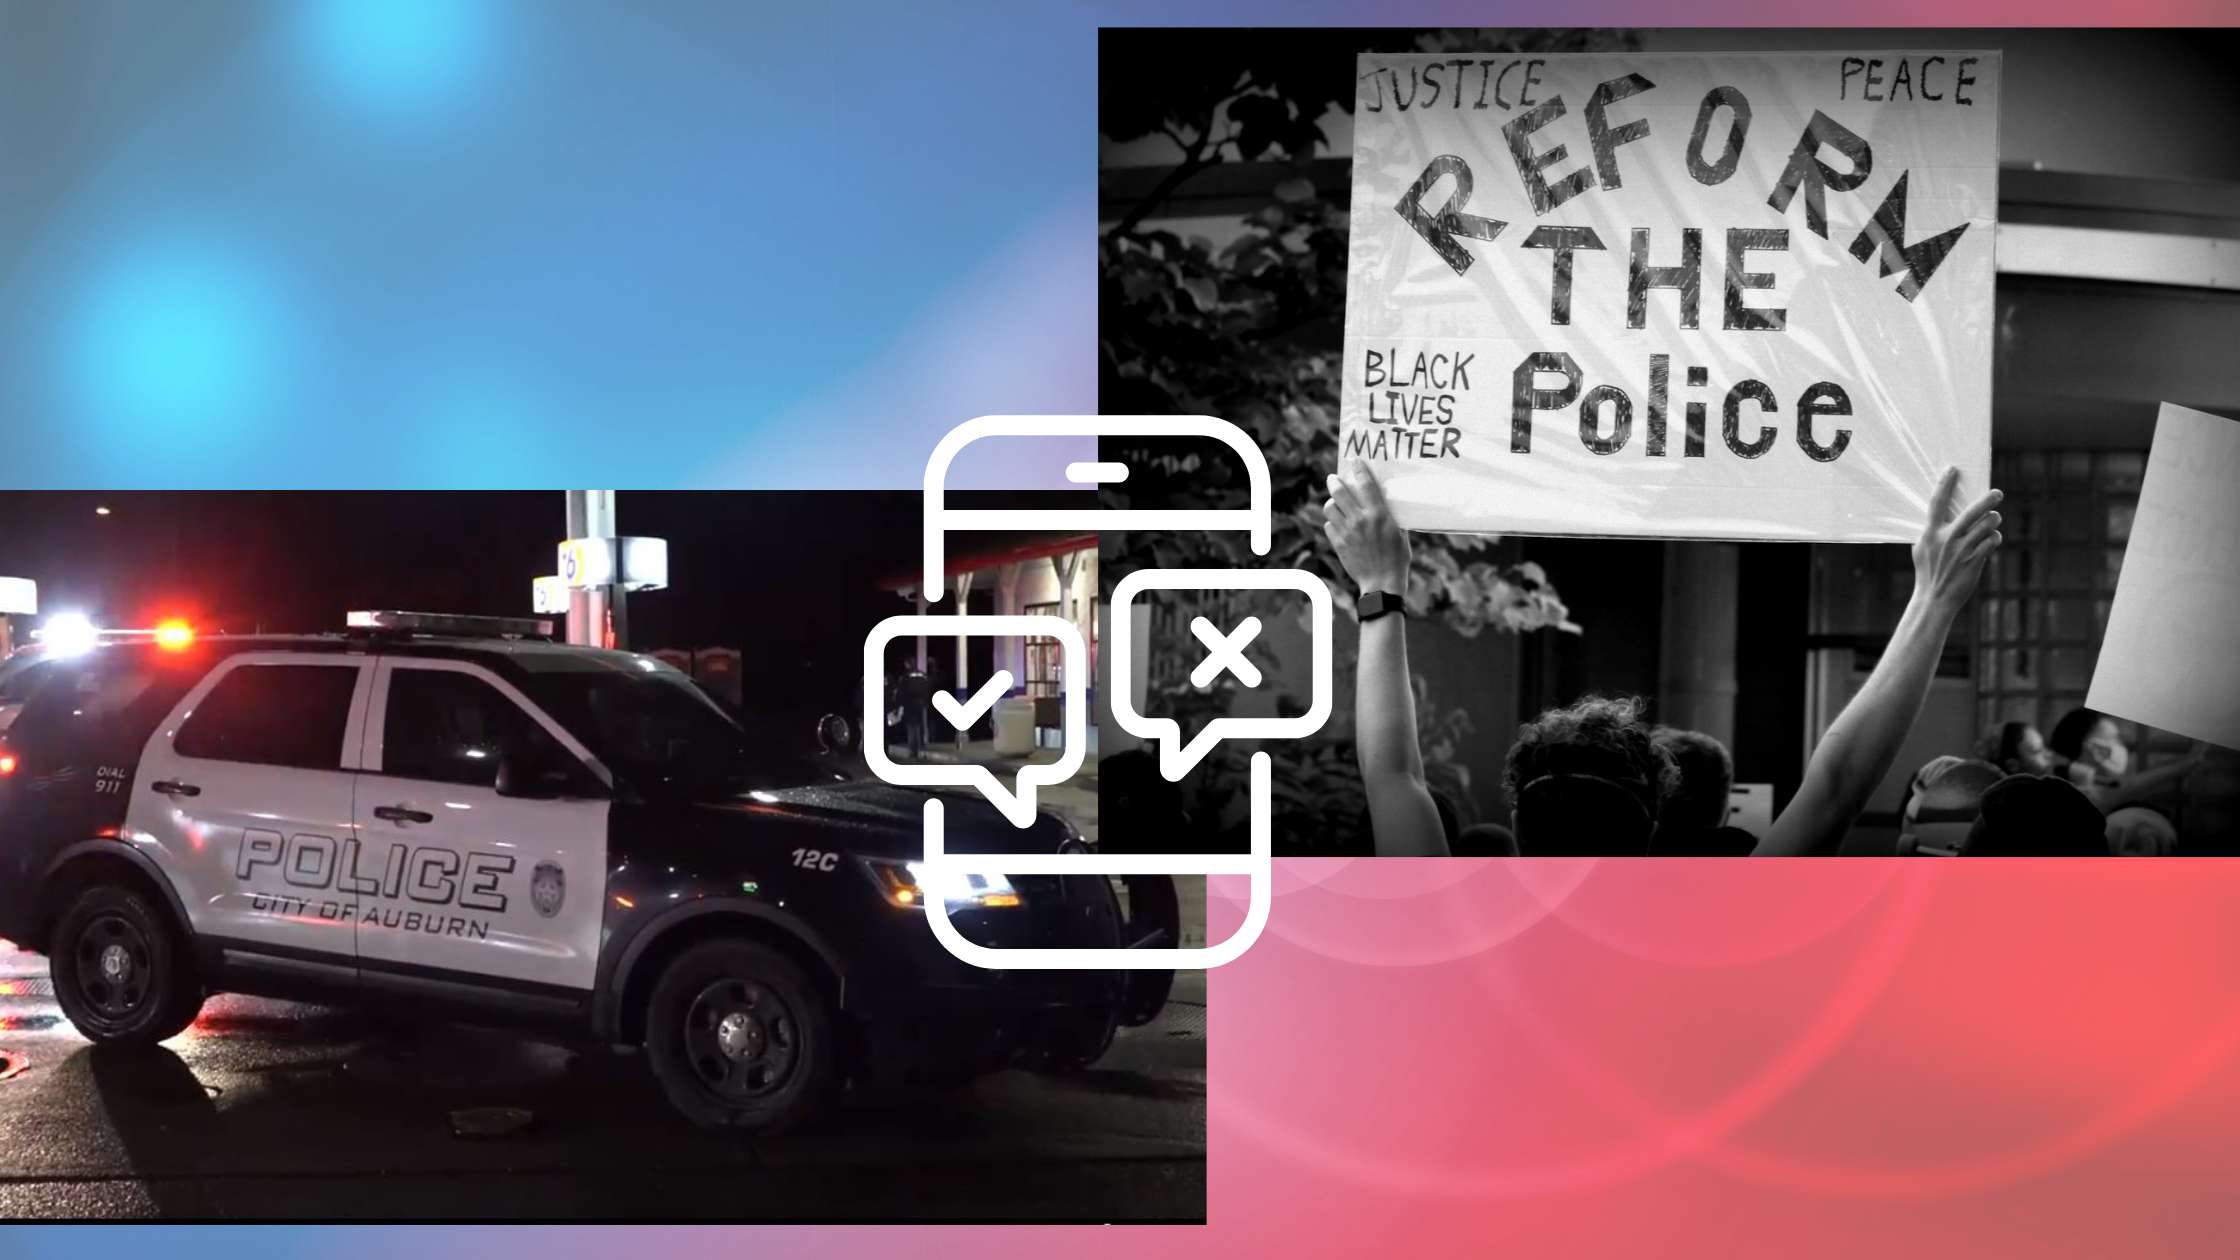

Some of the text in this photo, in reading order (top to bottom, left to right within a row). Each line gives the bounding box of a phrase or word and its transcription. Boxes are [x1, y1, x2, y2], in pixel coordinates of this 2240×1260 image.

[1359, 59, 1546, 112] JUSTICE
[1840, 56, 1978, 106] PEACE
[1394, 72, 1971, 303] REFORM
[1521, 225, 1790, 331] THE
[1365, 347, 1475, 390] BLACK
[1369, 391, 1455, 425] LIVES
[1509, 351, 1853, 462] Police
[1344, 427, 1461, 461] MATTER
[95, 779, 120, 794] 911
[96, 766, 126, 779] DIAL
[235, 827, 516, 913] POLICE
[792, 848, 839, 871] 12C
[252, 892, 489, 939] CITY OF AUBURN
